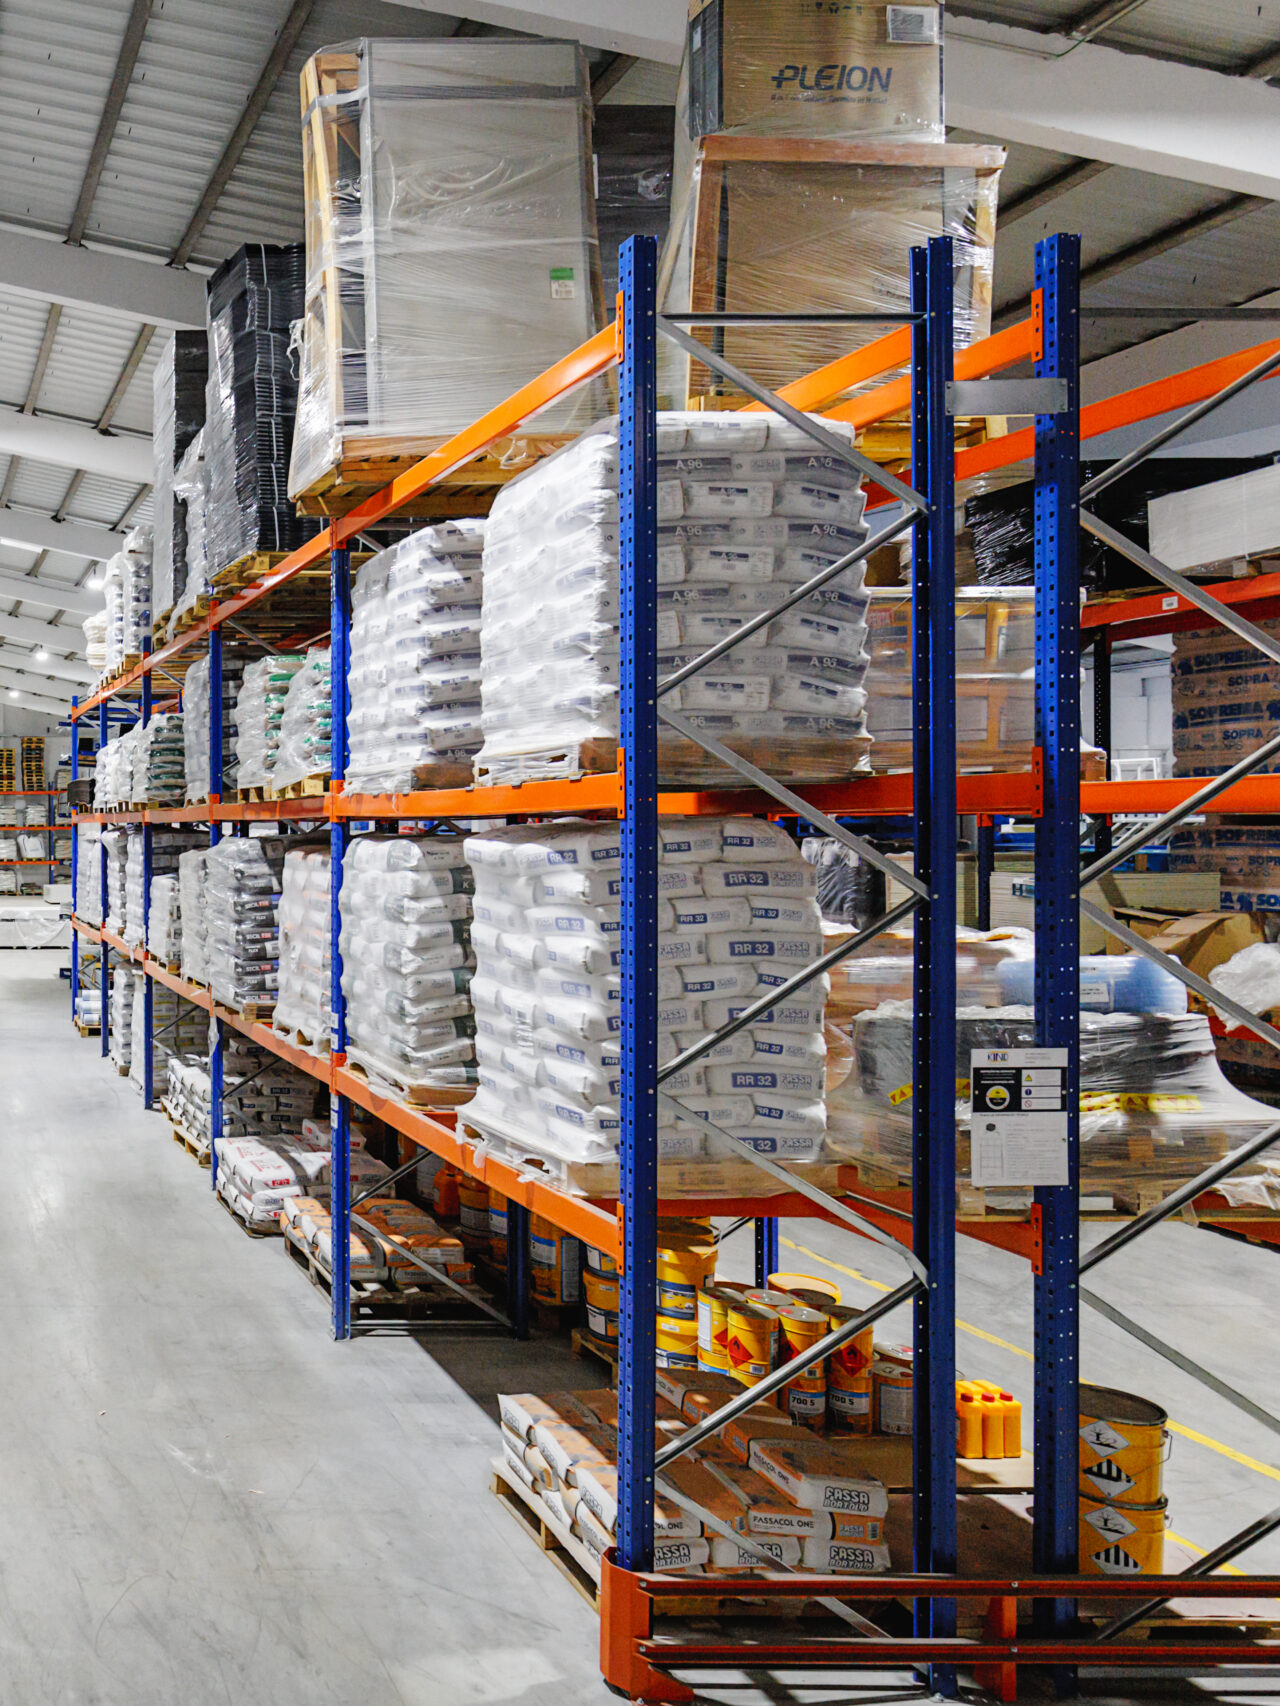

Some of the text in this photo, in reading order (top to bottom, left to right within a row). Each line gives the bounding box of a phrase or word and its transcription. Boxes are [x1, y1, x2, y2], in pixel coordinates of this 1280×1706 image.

[771, 65, 892, 92] PLEION
[676, 459, 703, 470] A 96
[676, 526, 702, 536] A 96
[811, 525, 837, 536] A 96
[673, 590, 699, 600] A 96
[810, 657, 837, 667] A 96
[1228, 674, 1270, 686] SOPRA
[1223, 728, 1263, 740] SOPRA
[550, 852, 574, 862] RR 32
[729, 874, 764, 884] RR 32
[734, 944, 769, 954] RR 32
[757, 1042, 770, 1050] RR
[737, 1075, 772, 1085] RR 32
[757, 1140, 772, 1150] 32
[791, 1396, 808, 1406] 700
[778, 1472, 790, 1484] ONE
[824, 1486, 869, 1504] FASSA
[823, 1498, 868, 1512] BORTOLO
[668, 1521, 684, 1529] ONE
[753, 1516, 814, 1528] FASSACOL ONE
[654, 1544, 690, 1561] ASSA
[830, 1546, 874, 1563] FASSA
